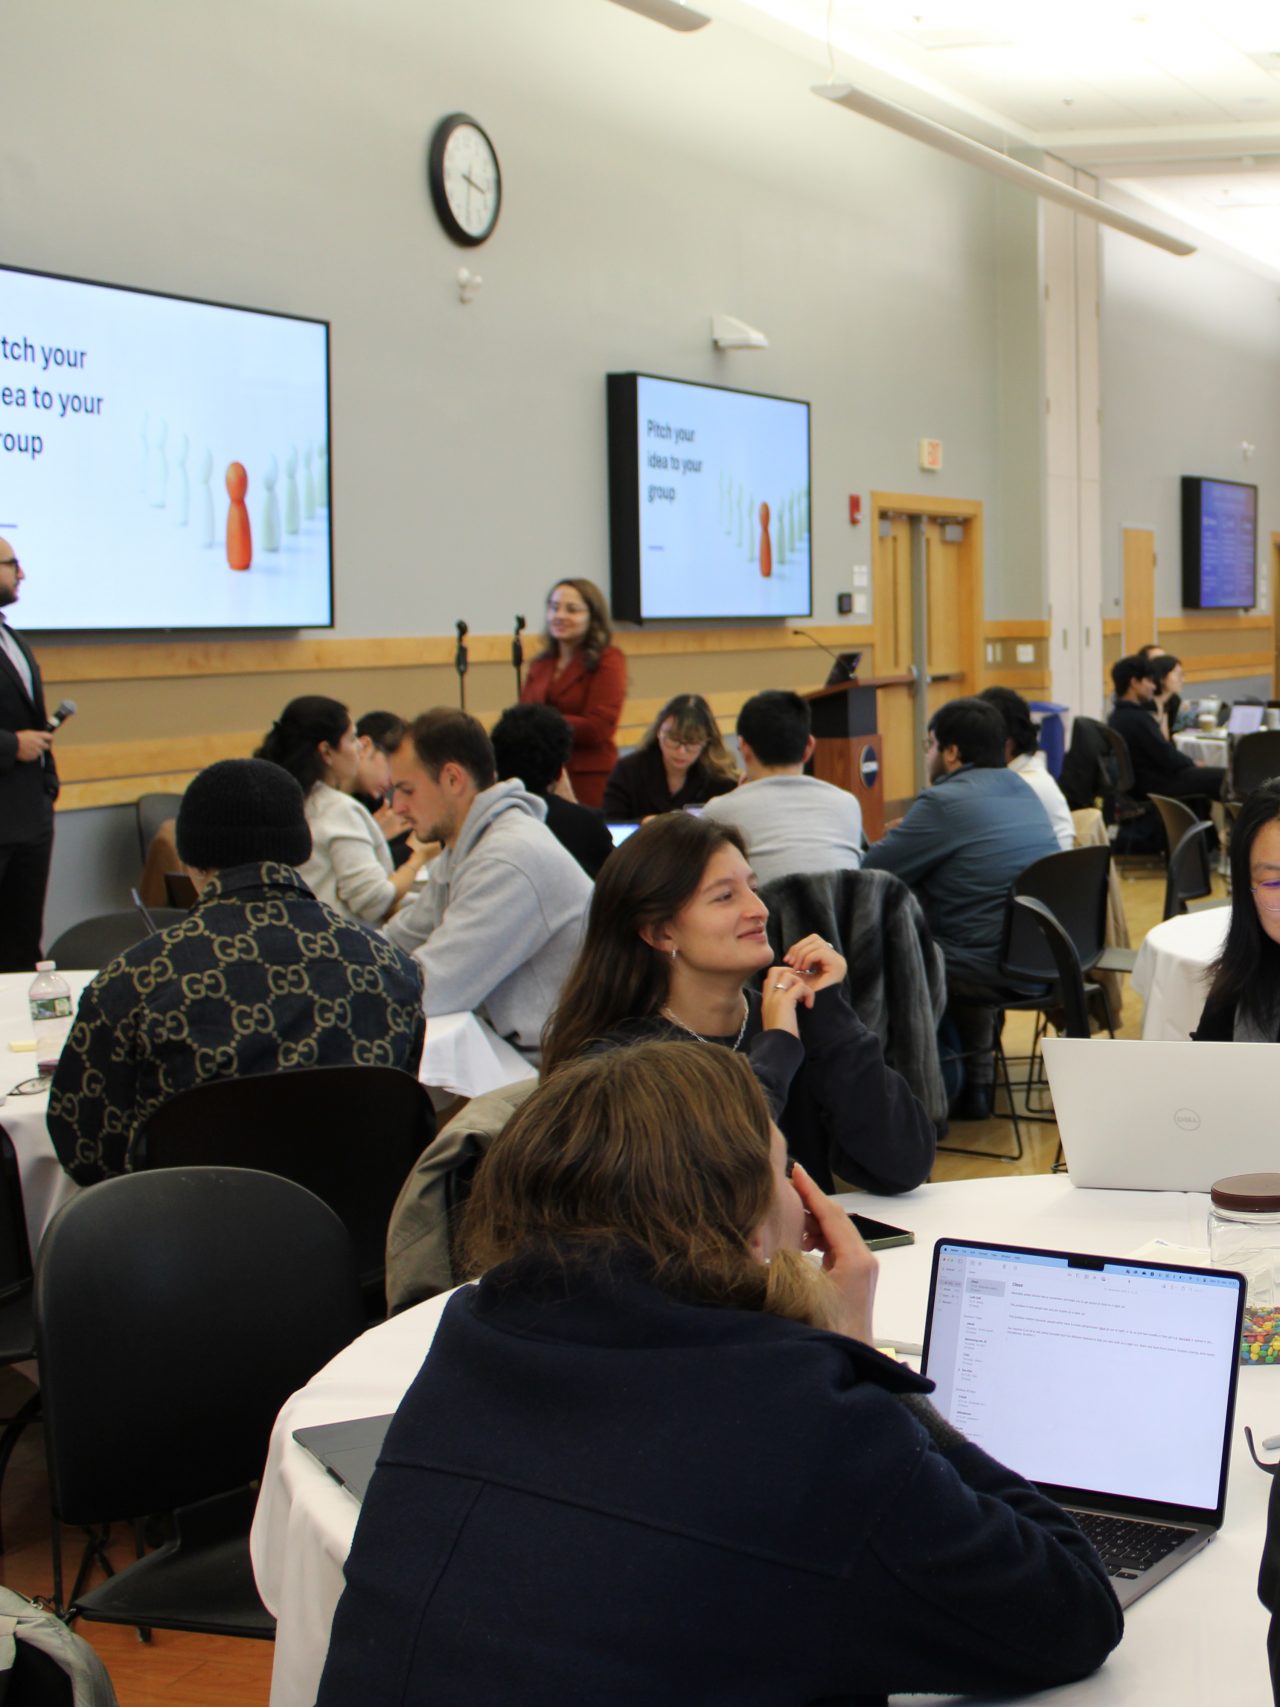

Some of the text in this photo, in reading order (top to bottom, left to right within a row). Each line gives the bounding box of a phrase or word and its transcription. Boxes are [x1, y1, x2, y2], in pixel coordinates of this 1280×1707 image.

[41, 345, 87, 370] your
[32, 385, 53, 410] to
[58, 391, 104, 418] your
[647, 419, 695, 444] Pitch your
[0, 432, 43, 460] oup
[647, 450, 702, 475] idea to your
[648, 484, 676, 504] group
